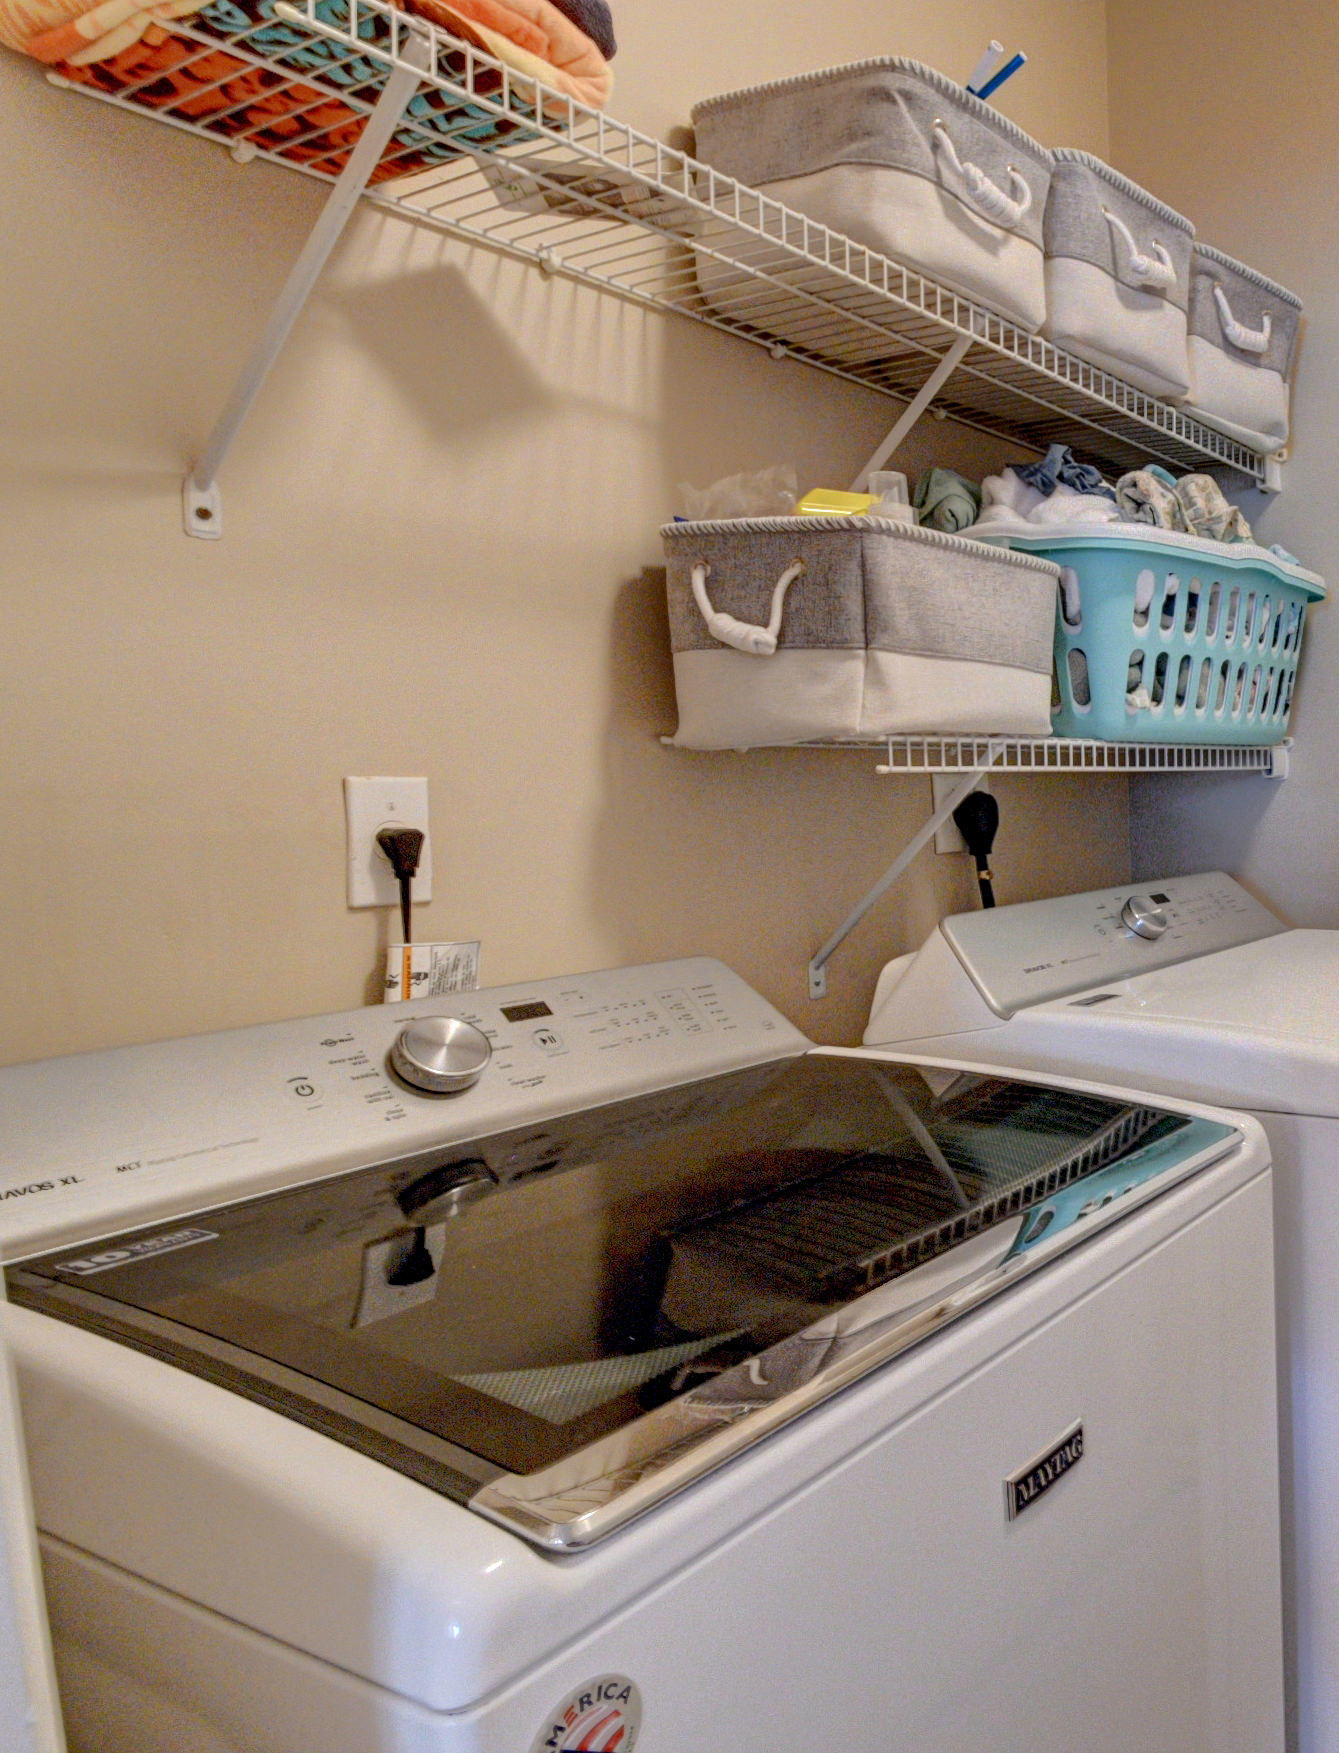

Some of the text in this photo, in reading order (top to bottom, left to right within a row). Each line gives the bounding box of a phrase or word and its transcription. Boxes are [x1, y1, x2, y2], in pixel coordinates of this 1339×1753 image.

[0, 1176, 86, 1200] AVOS XL
[1016, 1434, 1083, 1506] MAYTAG
[544, 1682, 632, 1753] MERICA
